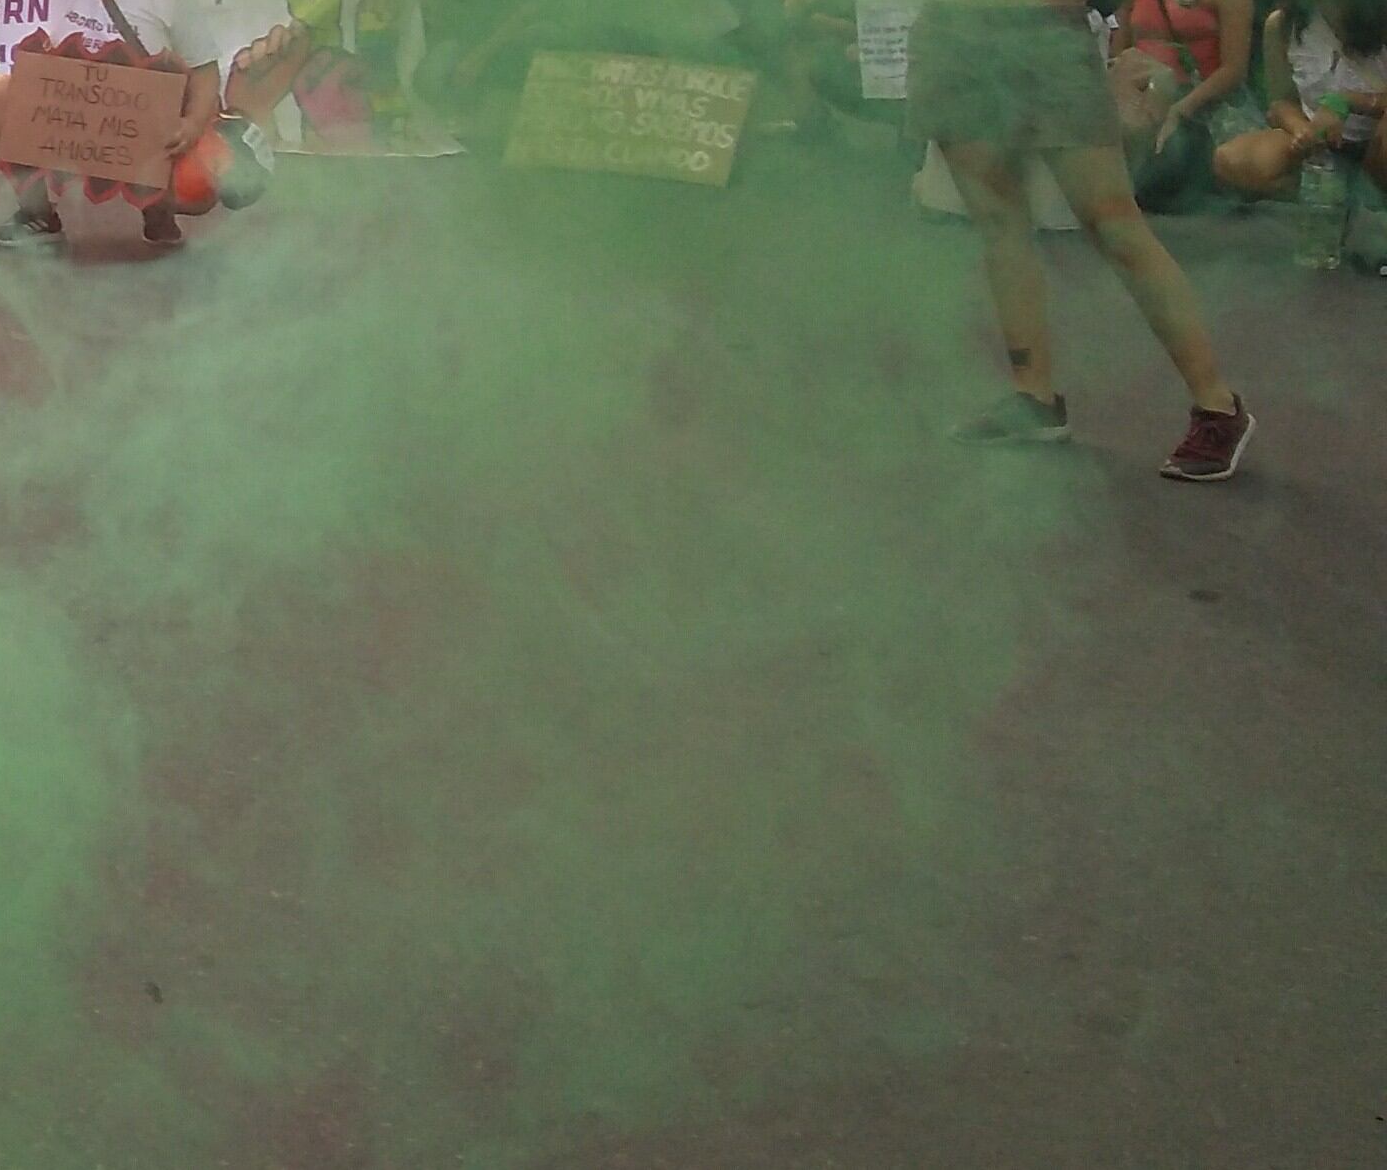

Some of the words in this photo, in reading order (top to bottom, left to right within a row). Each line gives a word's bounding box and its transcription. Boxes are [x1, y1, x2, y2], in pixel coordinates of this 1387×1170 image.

[80, 63, 109, 81] TU
[31, 105, 88, 131] MATA
[98, 116, 140, 138] MIS
